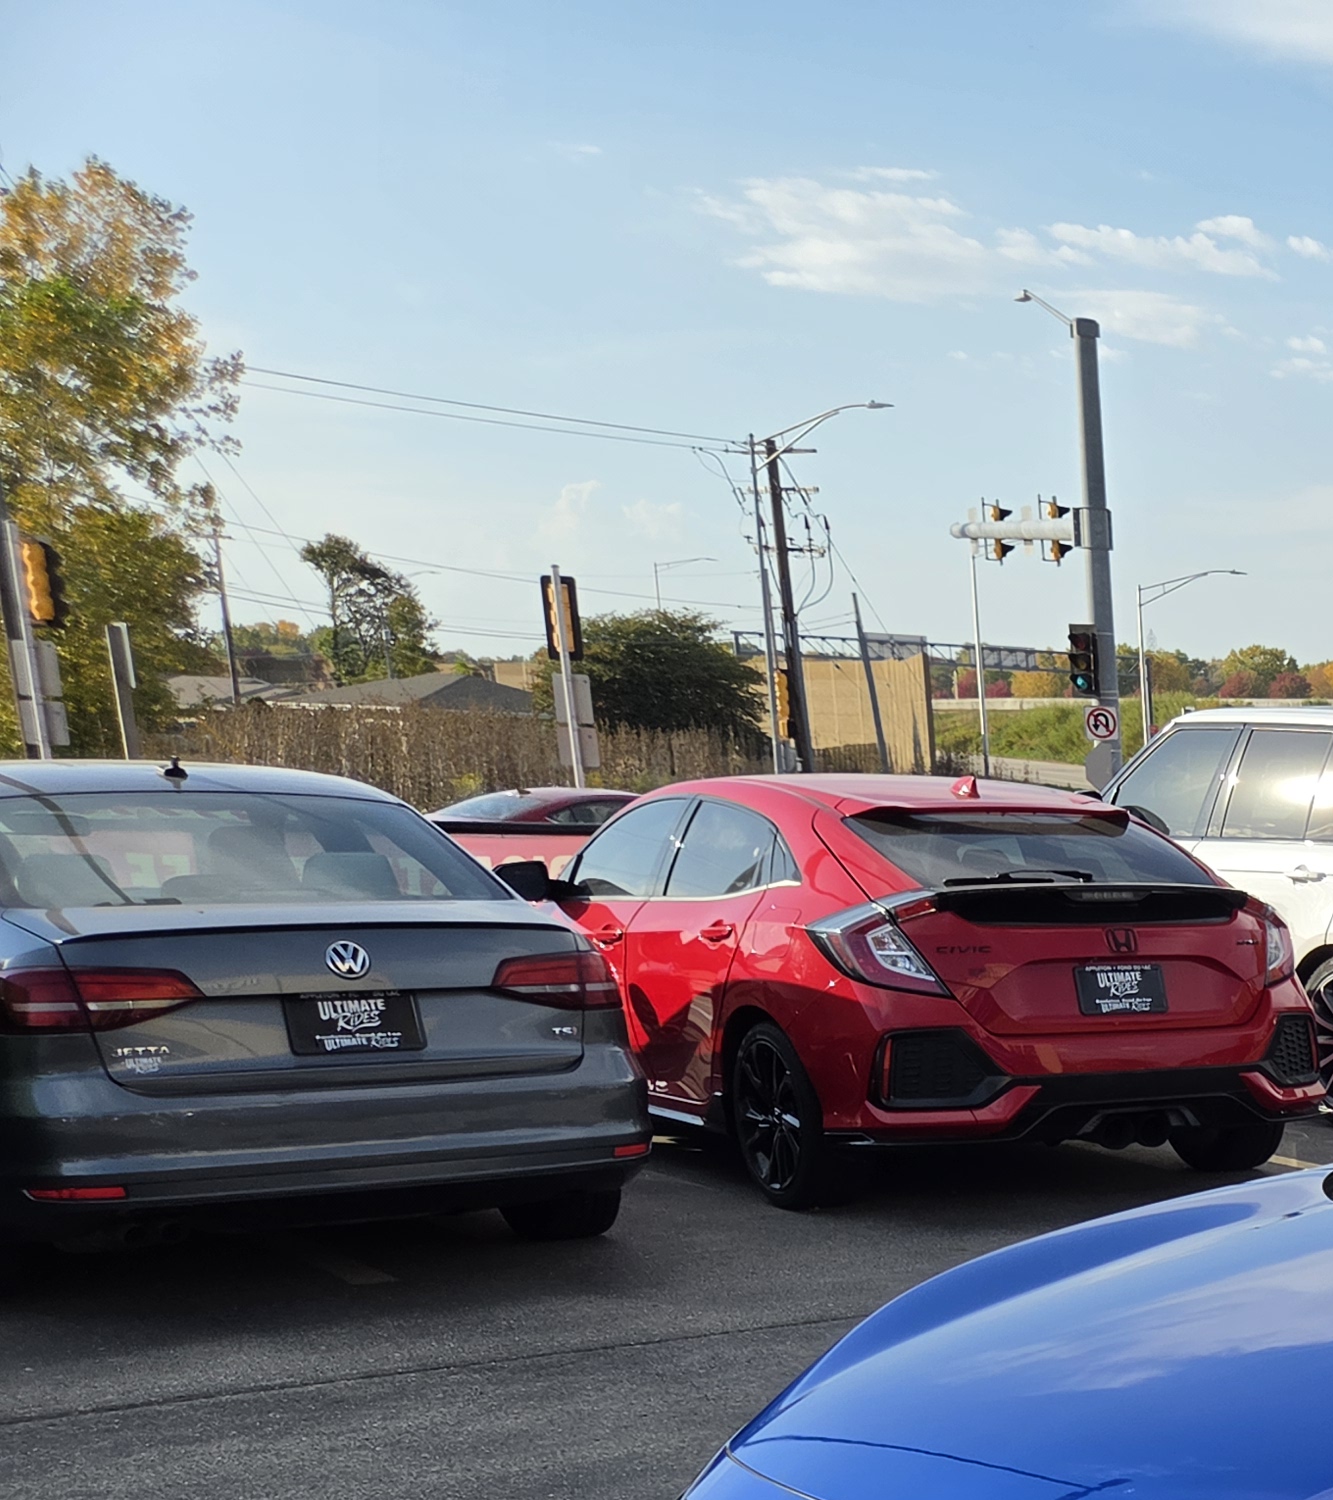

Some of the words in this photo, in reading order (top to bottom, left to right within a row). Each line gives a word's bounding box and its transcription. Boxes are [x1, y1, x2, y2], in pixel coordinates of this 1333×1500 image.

[936, 946, 991, 954] CIVIC
[1097, 971, 1142, 988] ULTIMATE
[318, 999, 386, 1020] ULTIMATE
[111, 1046, 170, 1057] JETTA
